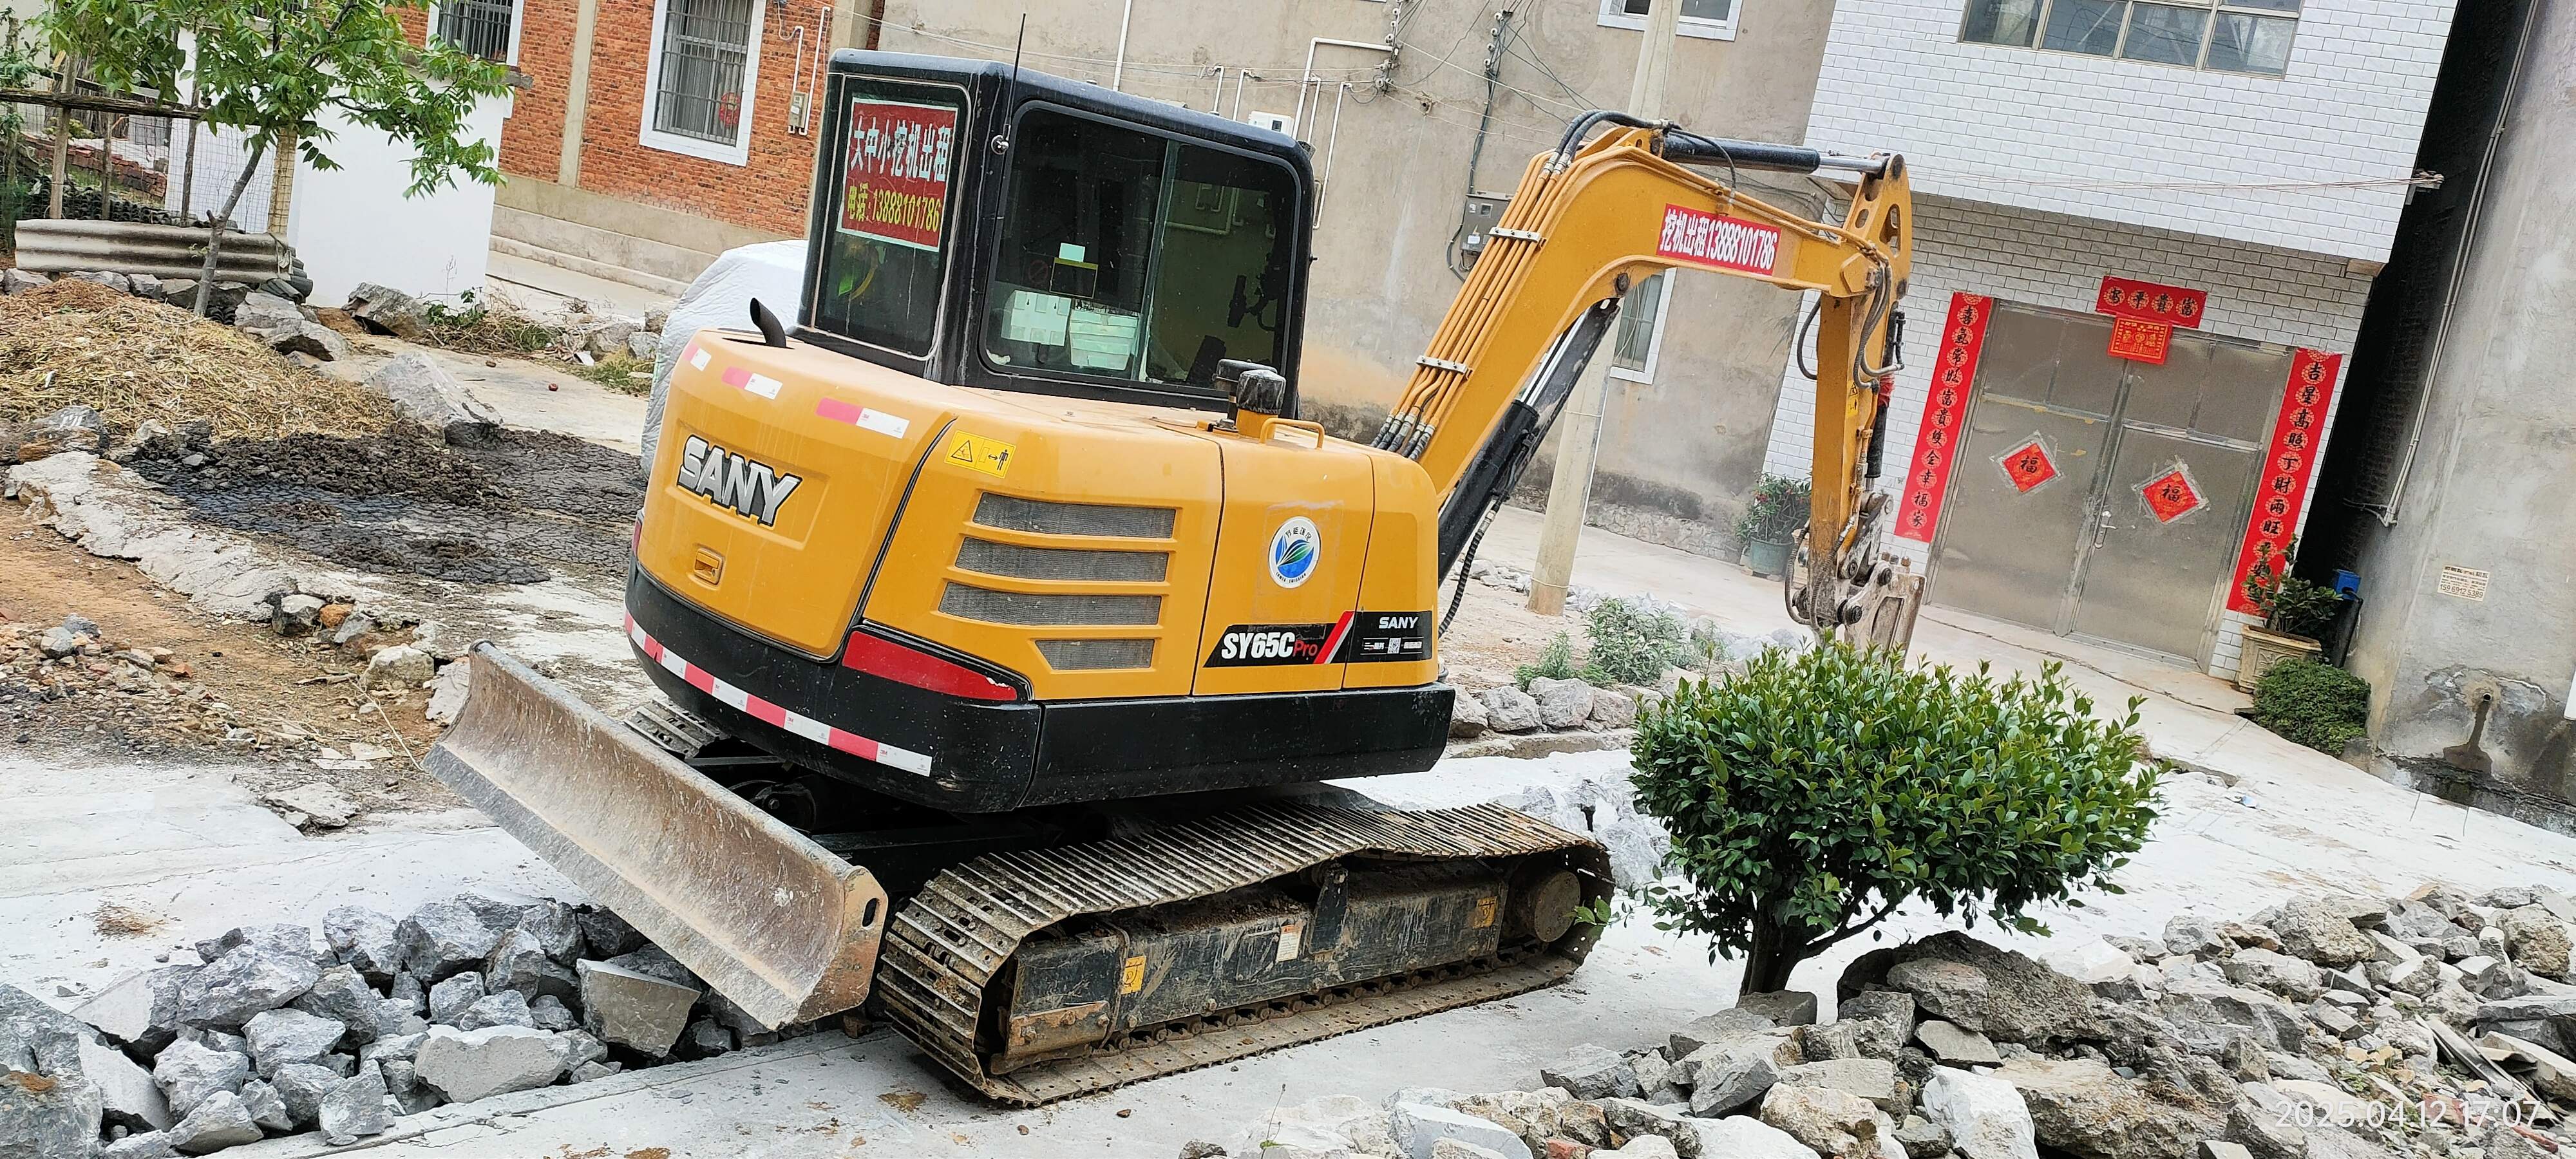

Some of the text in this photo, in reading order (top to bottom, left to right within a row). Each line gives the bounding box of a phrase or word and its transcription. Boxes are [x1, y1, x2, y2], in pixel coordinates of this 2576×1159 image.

[850, 115, 951, 182] 大中小挖机出租
[2020, 455, 2040, 474] 福
[677, 435, 803, 527] SANY
[2162, 484, 2181, 502] 福
[2439, 583, 2451, 592] 159
[2451, 586, 2467, 596] 6912
[2467, 589, 2484, 598] 5389
[1378, 616, 1419, 629] SANY
[1221, 632, 1318, 659] SY65C Pro
